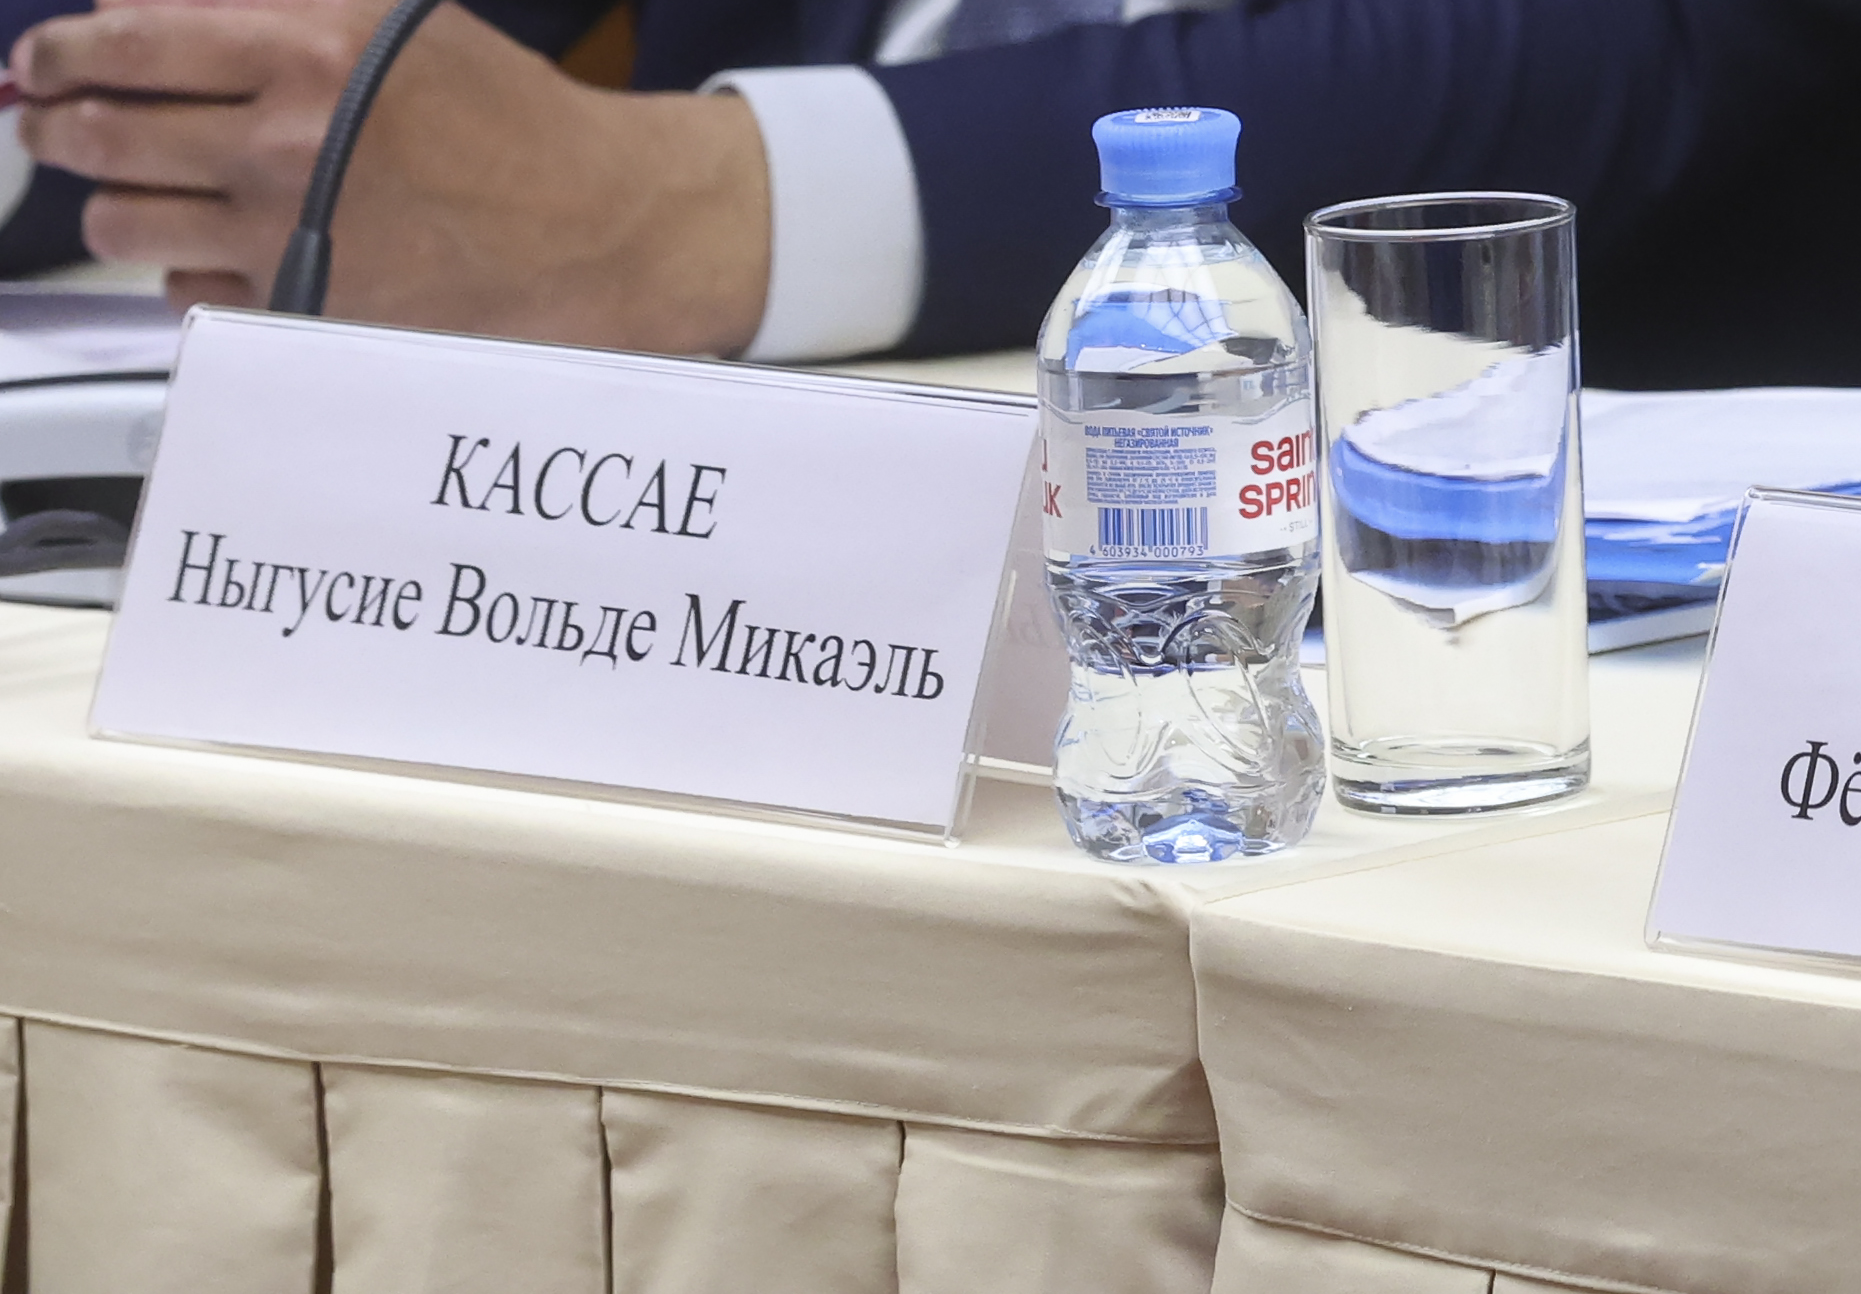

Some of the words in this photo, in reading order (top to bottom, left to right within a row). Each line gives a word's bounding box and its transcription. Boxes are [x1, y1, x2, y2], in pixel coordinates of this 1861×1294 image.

[430, 433, 728, 540] КАССАЕ
[168, 529, 424, 639] Ныгусие
[434, 561, 657, 667] Вольде
[668, 591, 945, 701] Микаэль
